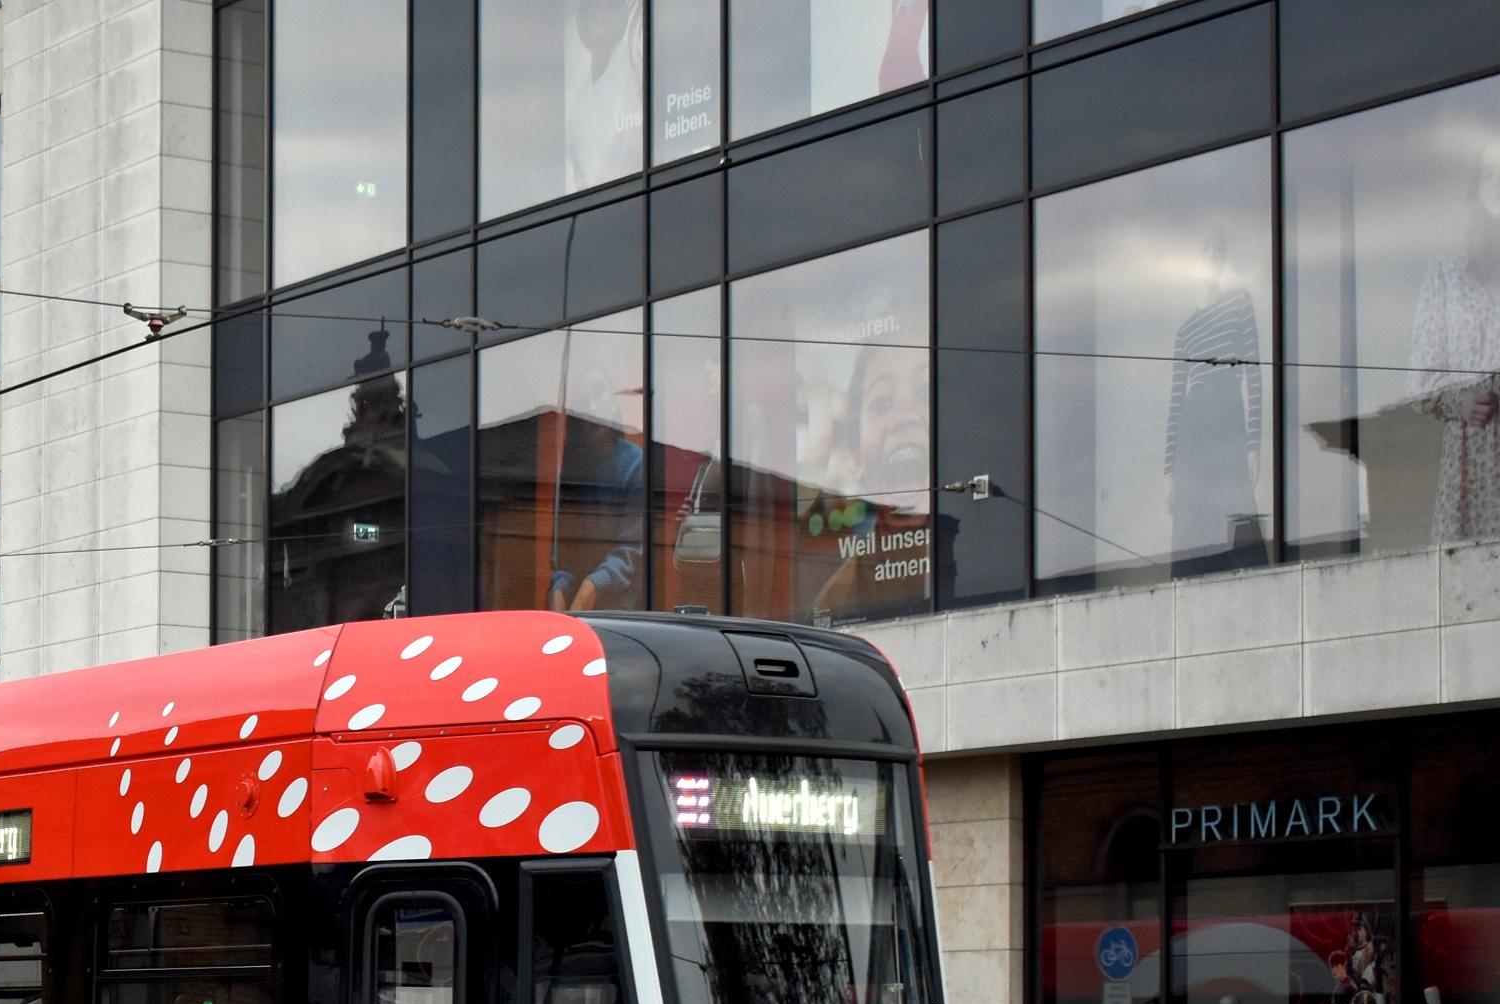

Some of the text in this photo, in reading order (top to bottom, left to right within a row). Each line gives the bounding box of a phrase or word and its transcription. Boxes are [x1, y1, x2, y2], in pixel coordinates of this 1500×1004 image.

[666, 85, 712, 114] Preise
[665, 111, 712, 140] leiben.
[838, 532, 876, 559] Weil
[874, 556, 931, 581] atmen
[1171, 792, 1378, 845] PRIMARK
